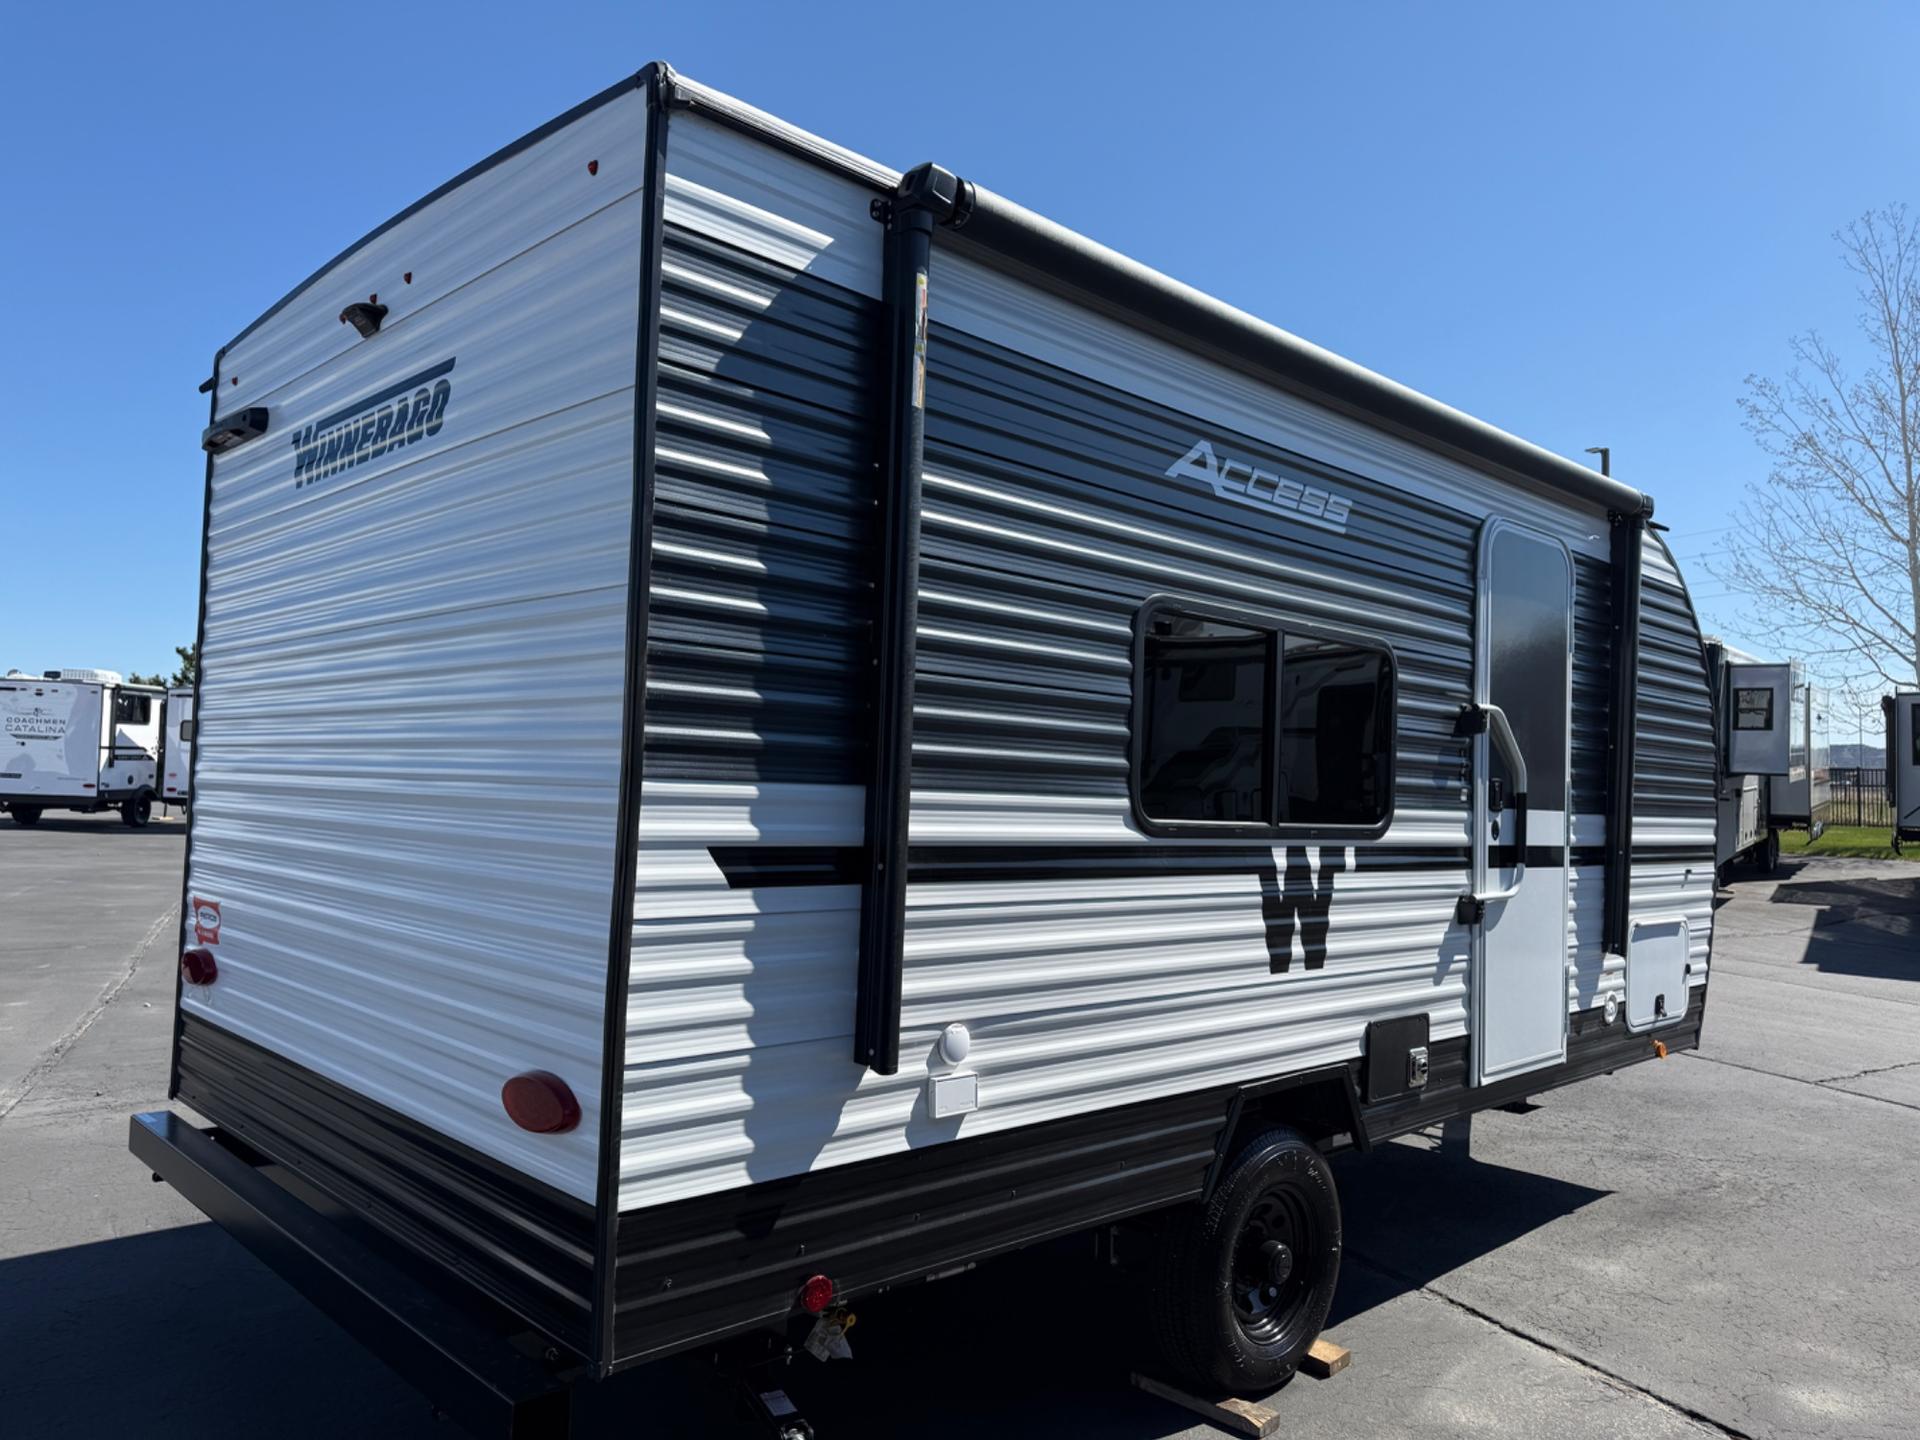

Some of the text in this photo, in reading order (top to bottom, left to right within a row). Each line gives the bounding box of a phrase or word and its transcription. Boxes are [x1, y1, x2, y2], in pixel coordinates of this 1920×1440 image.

[292, 366, 454, 489] WINNEBAGO
[1165, 440, 1352, 534] ACCESS
[5, 724, 66, 734] CATALINA
[6, 716, 67, 725] COACHMEN
